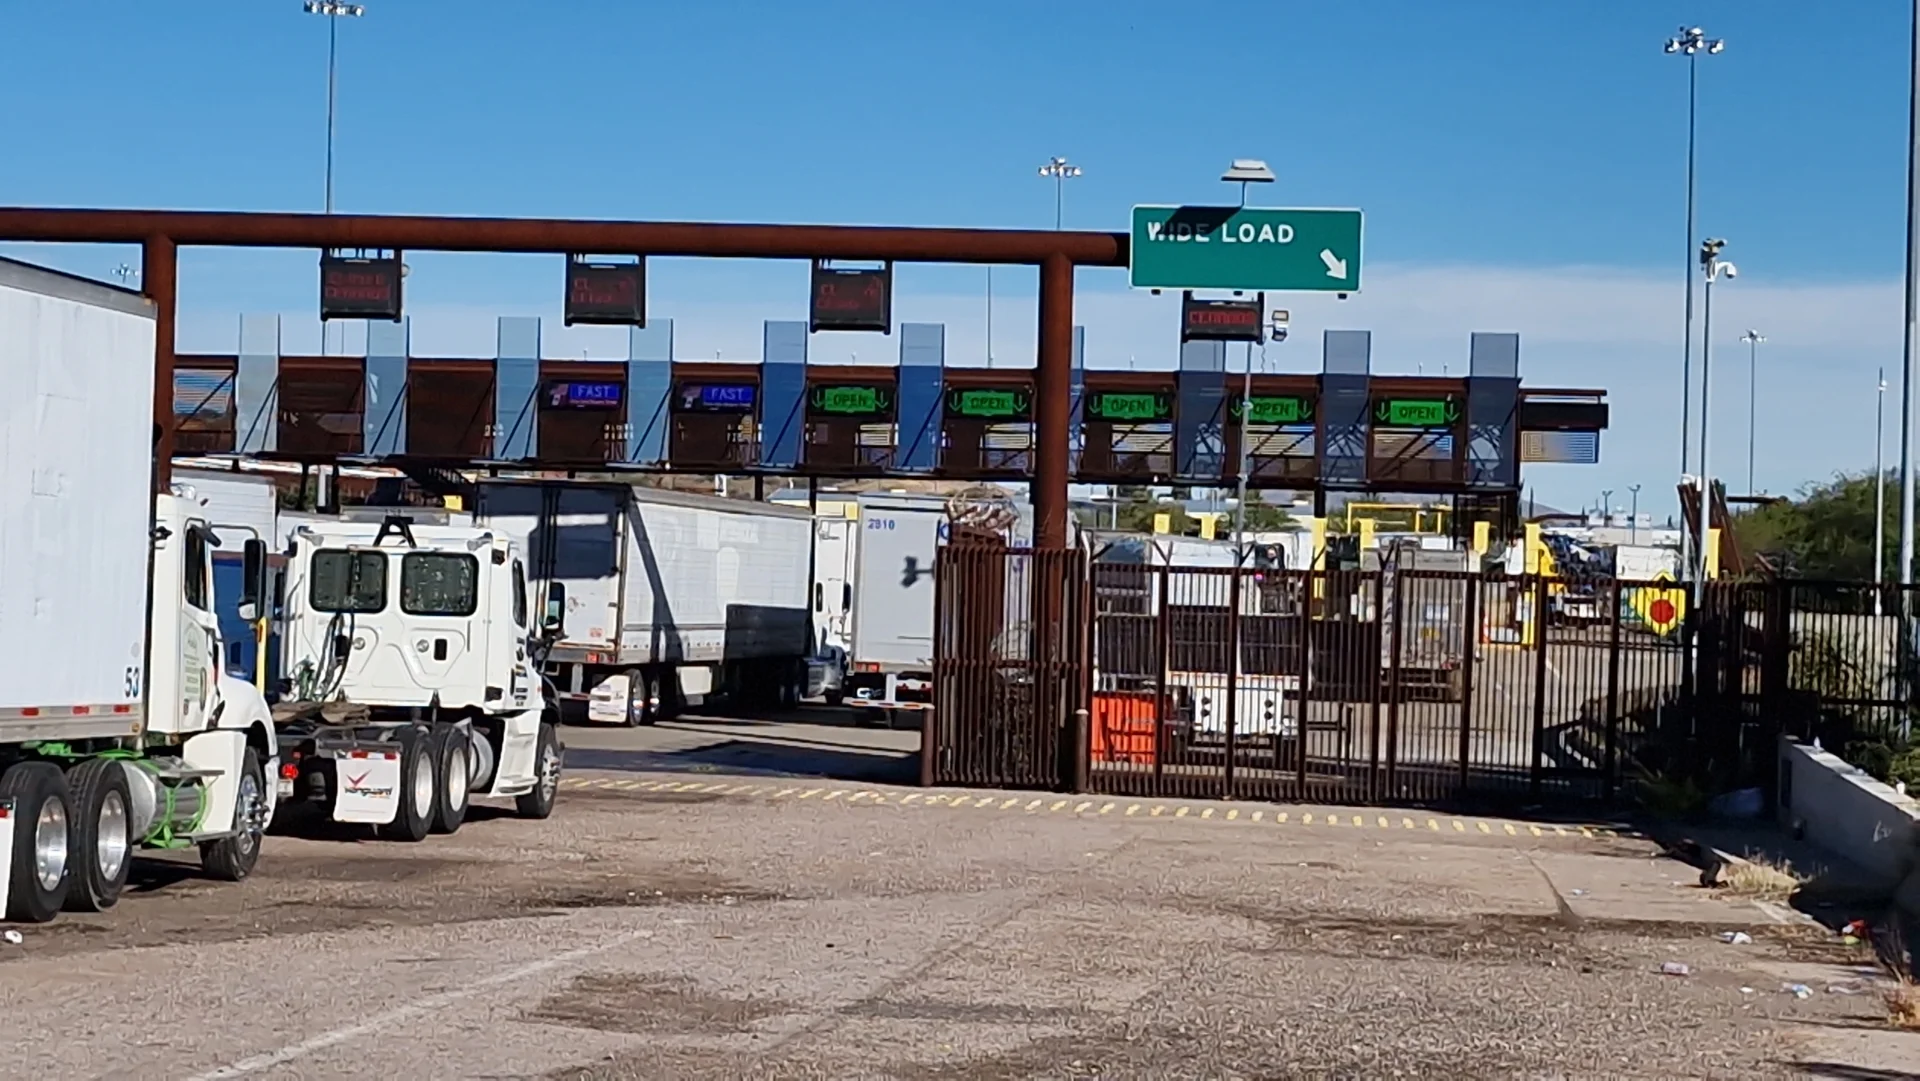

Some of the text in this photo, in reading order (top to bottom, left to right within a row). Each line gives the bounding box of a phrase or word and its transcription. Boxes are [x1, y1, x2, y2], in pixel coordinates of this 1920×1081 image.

[1147, 221, 1295, 243] WIDE LOAD
[577, 385, 610, 398] FAST
[711, 387, 744, 401] FAST
[832, 393, 868, 407] OPEN
[970, 396, 1008, 410] OPEN
[1110, 398, 1147, 413] OPEN
[1253, 401, 1290, 416] OPEN
[1399, 406, 1437, 419] OPEN
[124, 666, 140, 698] 53
